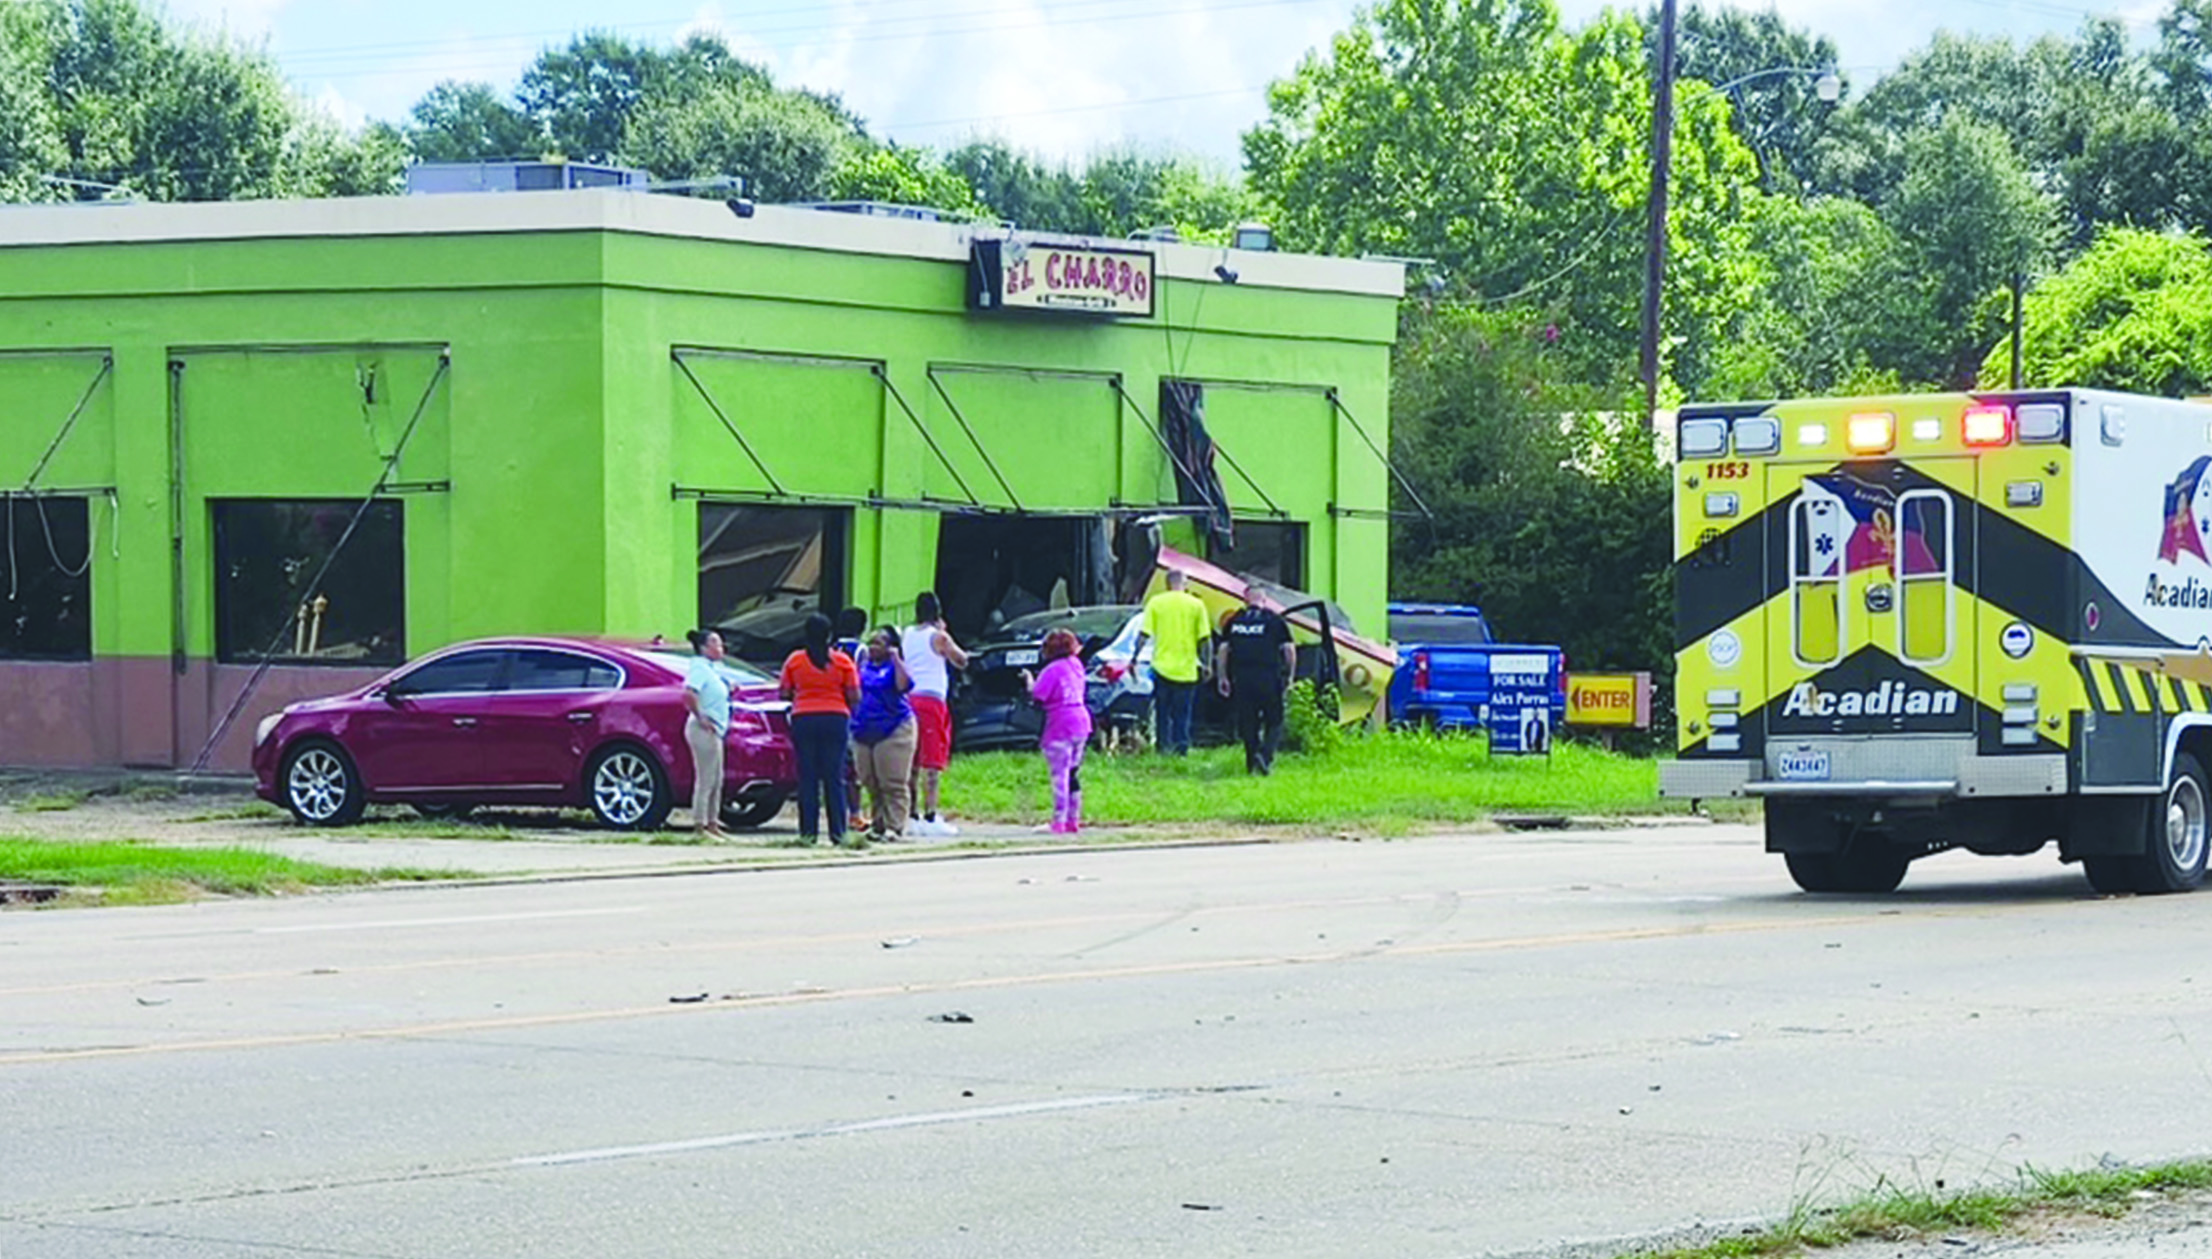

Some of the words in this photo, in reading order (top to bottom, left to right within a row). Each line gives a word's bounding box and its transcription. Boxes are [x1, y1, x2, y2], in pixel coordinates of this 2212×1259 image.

[1007, 259, 1034, 295] EL
[1046, 252, 1147, 300] CHARRO
[1707, 462, 1749, 479] 1153
[1231, 624, 1265, 635] POLICE
[1493, 674, 1516, 687] FOR
[1518, 674, 1546, 687] SALE
[1581, 690, 1630, 708] ENTER
[1782, 681, 1958, 716] Acadian
